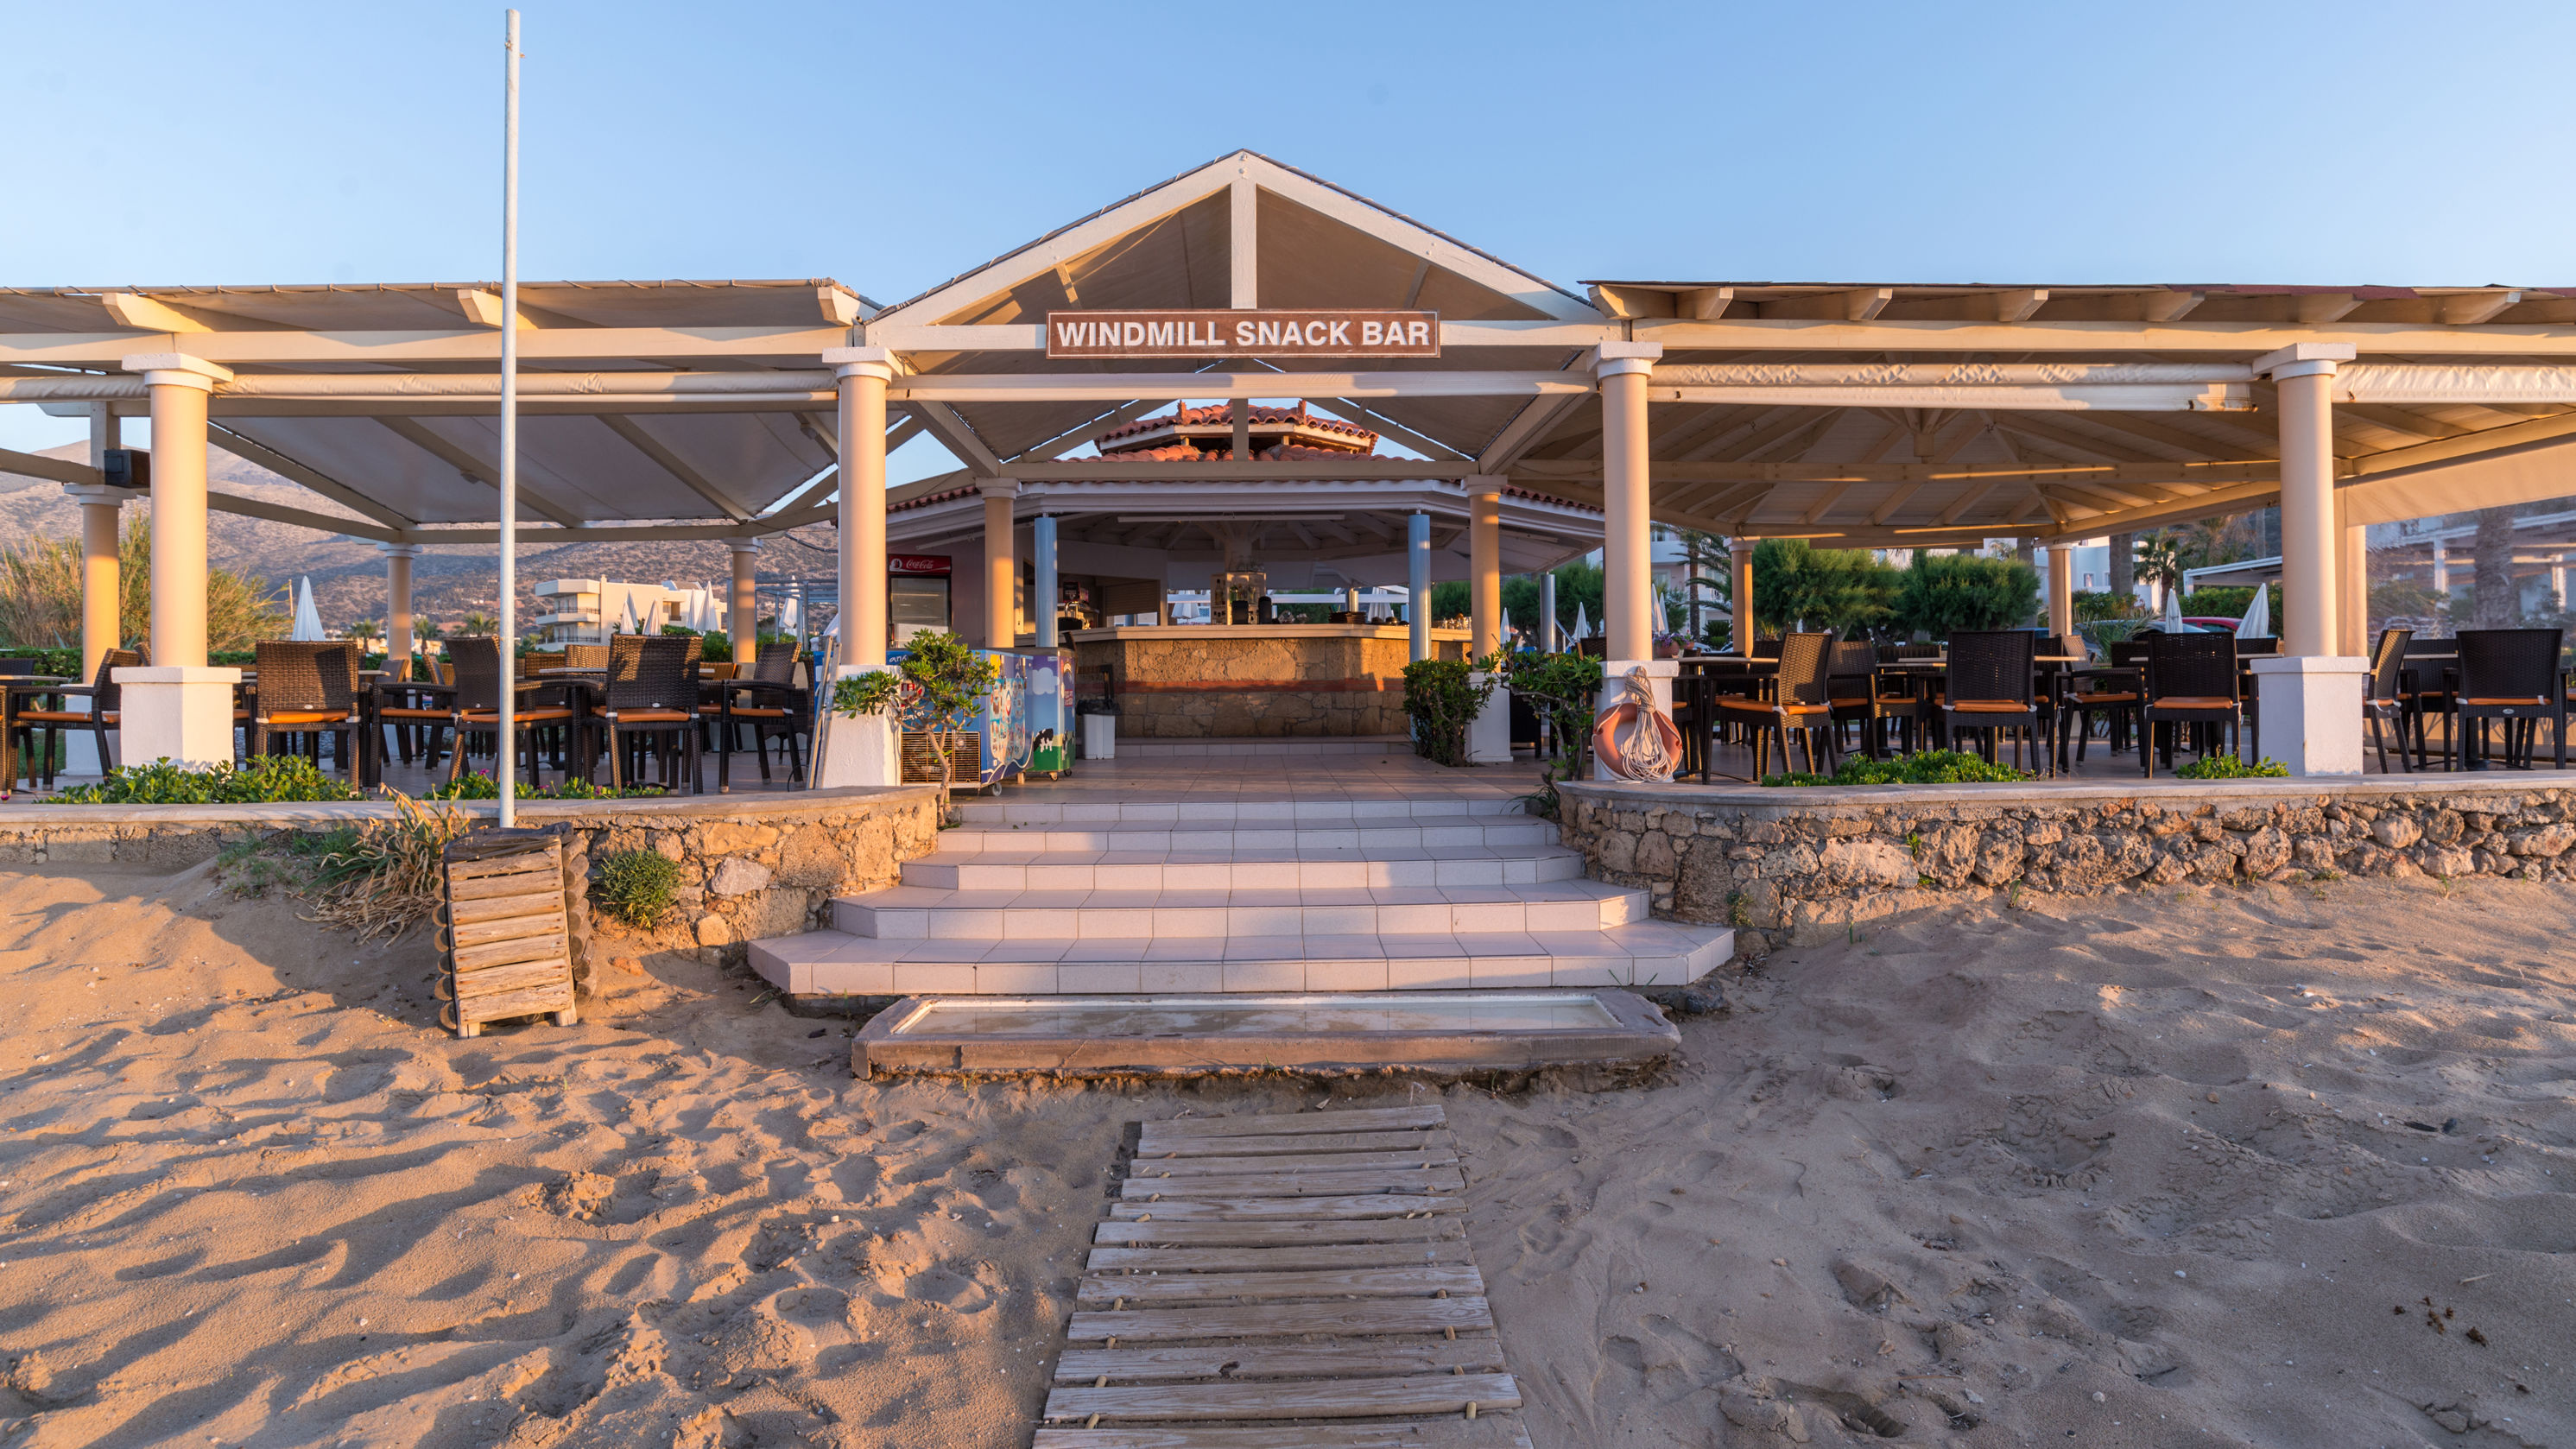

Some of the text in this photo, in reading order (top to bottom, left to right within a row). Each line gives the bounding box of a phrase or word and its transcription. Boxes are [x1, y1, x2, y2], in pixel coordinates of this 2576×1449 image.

[1056, 320, 1430, 347] WINDMILL SNACK BAR
